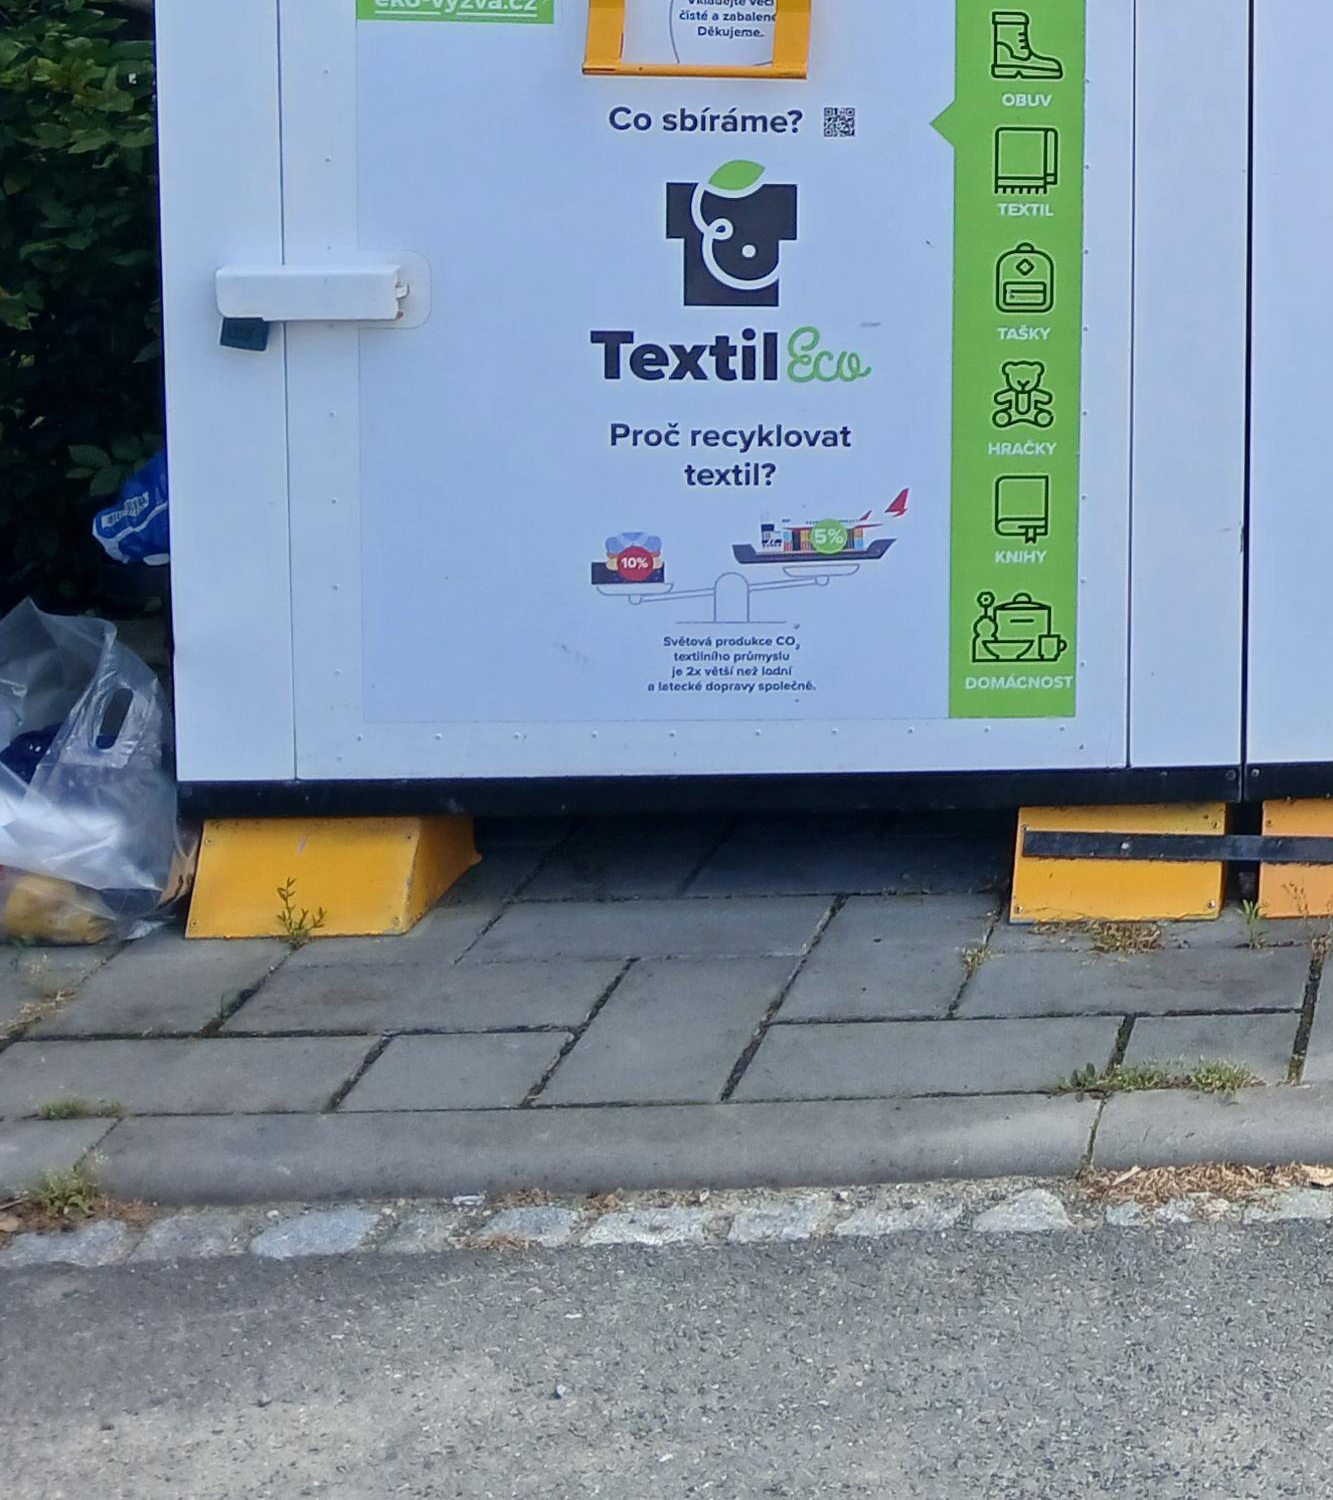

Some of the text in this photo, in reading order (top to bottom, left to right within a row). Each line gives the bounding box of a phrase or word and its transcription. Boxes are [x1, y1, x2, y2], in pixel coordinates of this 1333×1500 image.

[680, 10, 708, 20] čisté
[698, 26, 765, 39] Děkujeme.
[1002, 94, 1053, 108] OBUV
[608, 107, 803, 133] Co sbíráme?
[998, 203, 1054, 218] TEXTIL
[997, 325, 1051, 341] TAŠKY
[610, 422, 852, 453] Proč recyklovat
[988, 440, 1057, 456] HRAČKY
[685, 462, 777, 486] textil?
[813, 528, 845, 544] 5%
[621, 557, 649, 569] 10%
[995, 550, 1048, 564] KNIHY
[664, 636, 712, 647] Světová
[716, 636, 772, 648] produkce
[674, 650, 789, 663] textilního průmyslu
[671, 666, 792, 678] je 2x větší než lodní
[648, 680, 816, 693] a letecké dopravy společně.
[965, 673, 1073, 690] DOMÁCNOST
